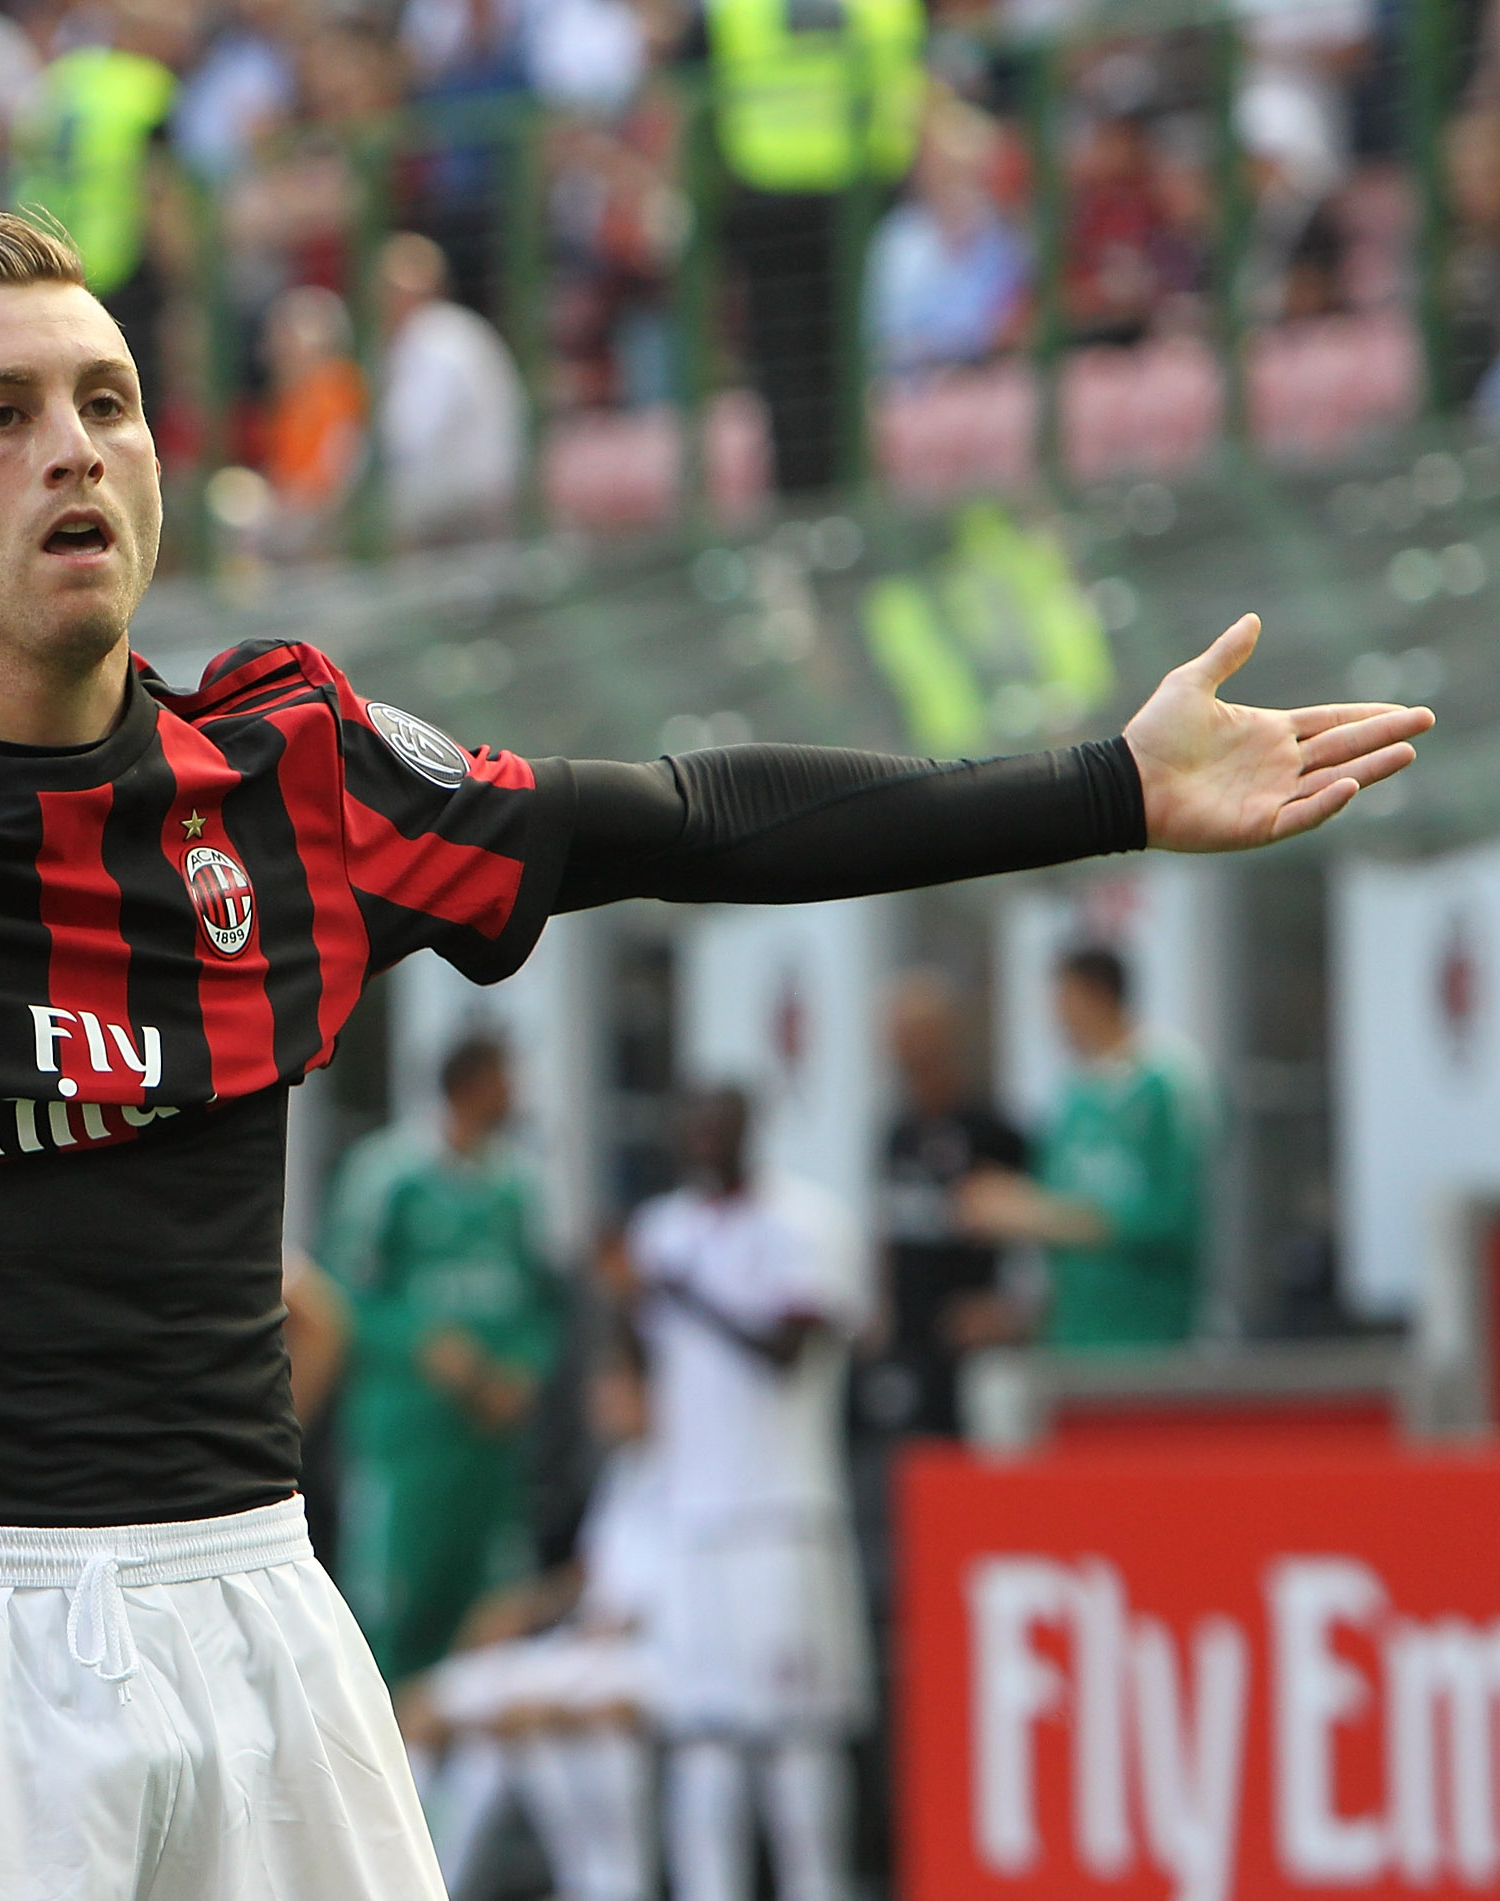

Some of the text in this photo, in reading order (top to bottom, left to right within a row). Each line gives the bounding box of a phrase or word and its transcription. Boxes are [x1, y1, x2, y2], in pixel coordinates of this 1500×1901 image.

[191, 850, 229, 869] ACM
[215, 928, 245, 944] 1899
[27, 1004, 162, 1087] Fly
[964, 1552, 1250, 1901] Fly
